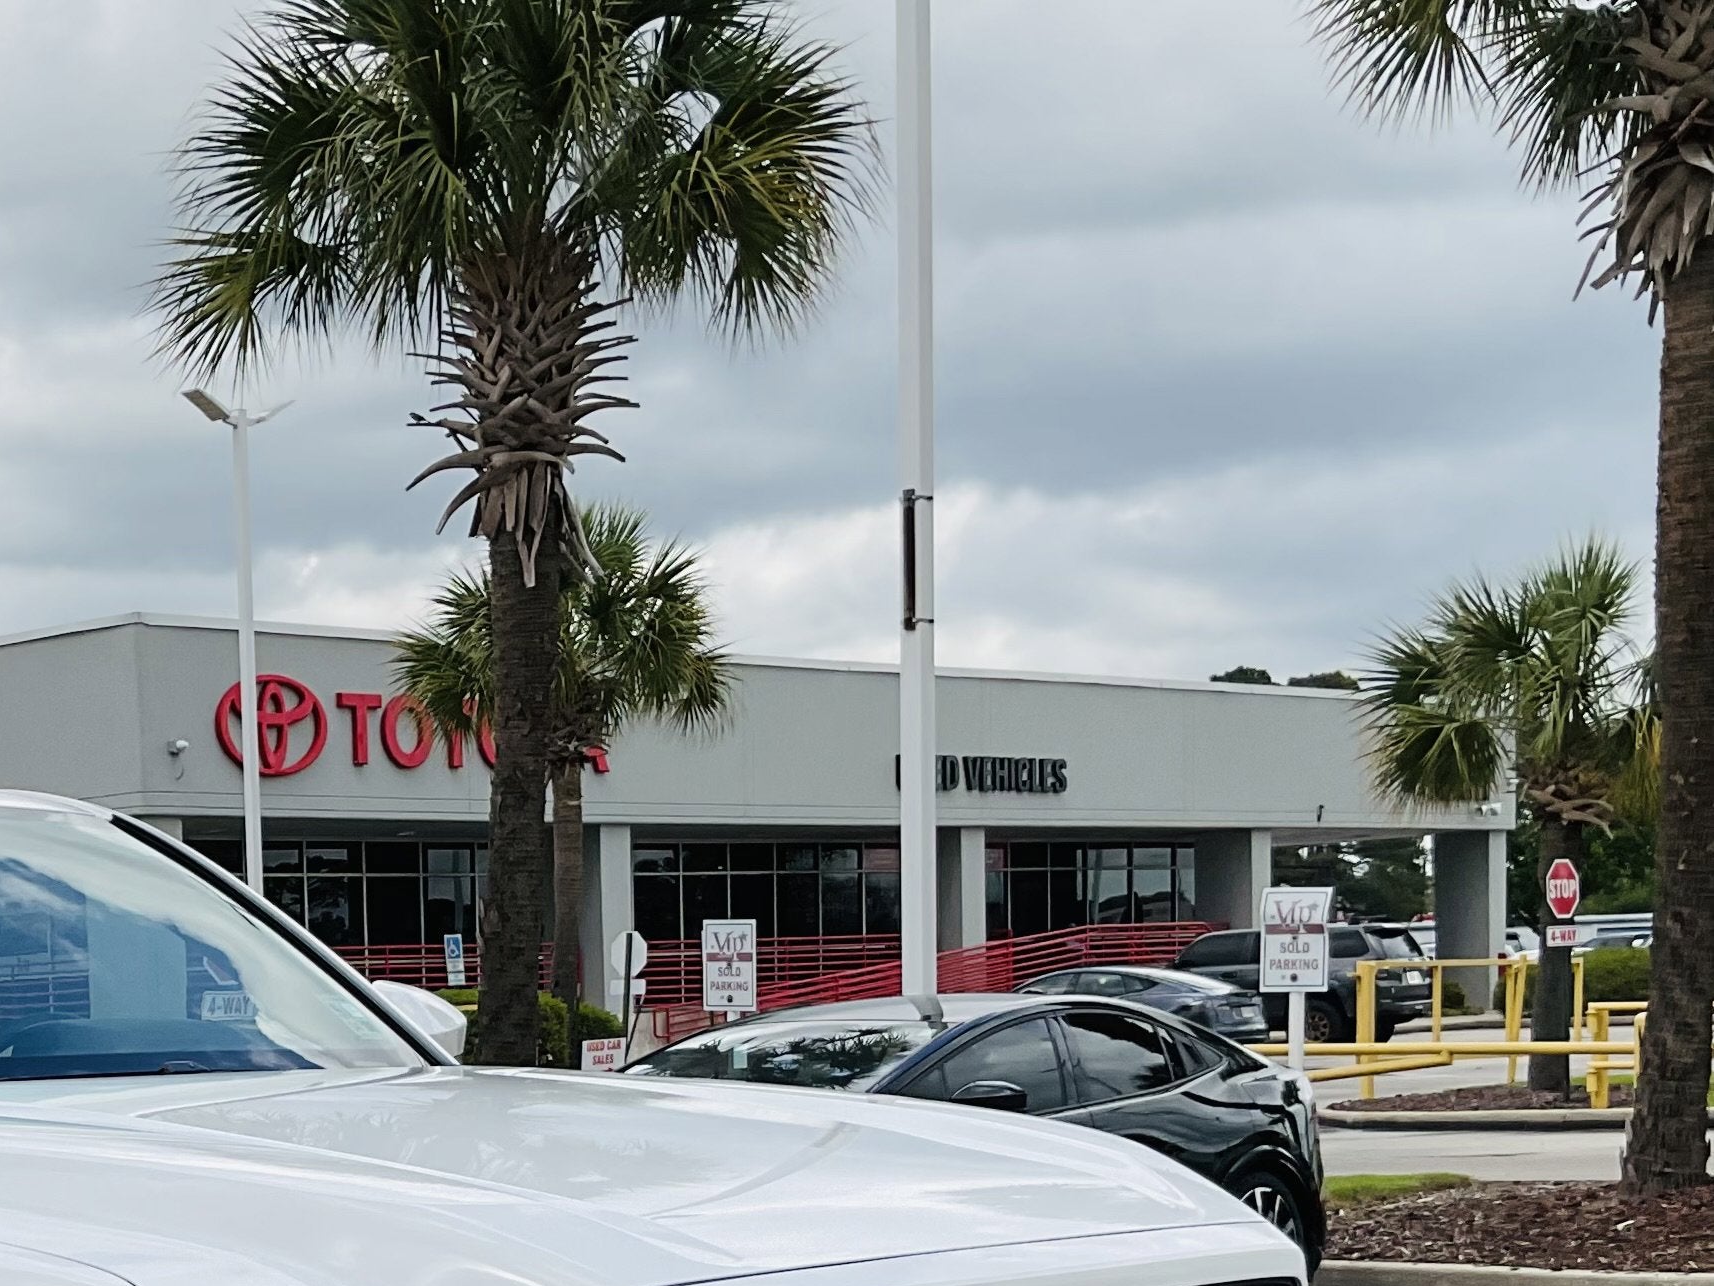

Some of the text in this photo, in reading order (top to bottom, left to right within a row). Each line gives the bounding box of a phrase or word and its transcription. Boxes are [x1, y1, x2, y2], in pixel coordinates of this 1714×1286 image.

[962, 756, 1068, 793] VEHICLES
[1549, 879, 1577, 899] STOP
[1551, 929, 1577, 942] 4-WAY
[1280, 942, 1310, 953] SOLD
[1270, 959, 1319, 970] PARKING
[717, 966, 741, 977] SOLD
[710, 981, 749, 991] PARKING
[206, 996, 250, 1016] 4-WAY
[607, 1039, 622, 1050] CAR
[592, 1053, 614, 1065] SALES
